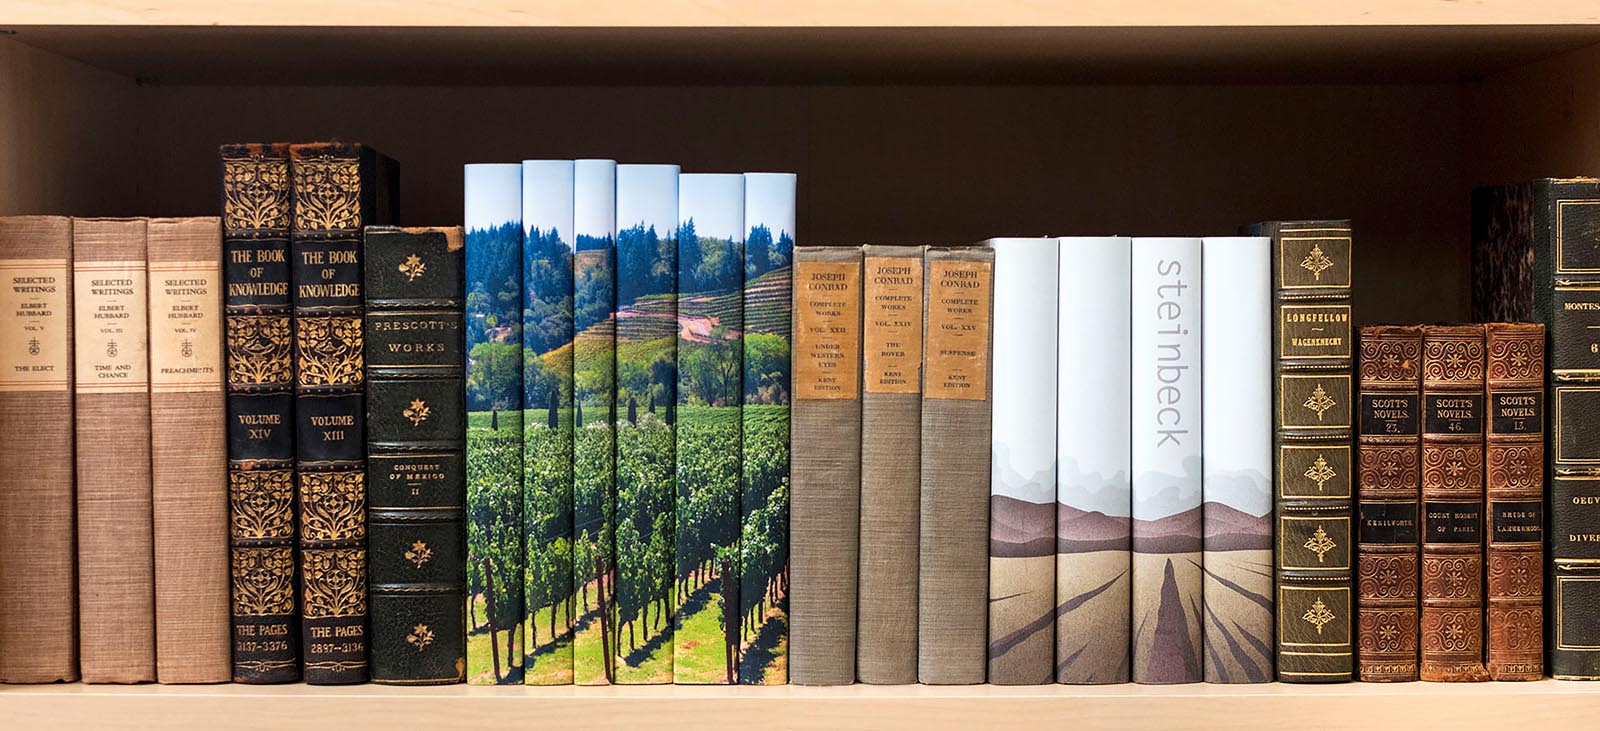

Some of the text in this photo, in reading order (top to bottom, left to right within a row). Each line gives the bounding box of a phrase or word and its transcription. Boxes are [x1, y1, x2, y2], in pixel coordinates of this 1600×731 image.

[231, 249, 285, 263] THE BOOK
[302, 251, 357, 264] THE BOOK
[250, 268, 264, 278] OF
[321, 269, 336, 279] OF
[812, 273, 845, 281] JOSEPH
[944, 270, 977, 279] JOSEPH
[91, 279, 133, 287] SELECTED
[165, 279, 207, 287] SELECTED
[874, 277, 913, 285] CONRAD
[941, 280, 980, 289] CONRAD
[229, 282, 288, 296] KNOWLEDGE
[299, 283, 360, 298] KNOWLEDGE
[808, 283, 848, 291] CONRAD
[91, 288, 134, 296] WRITINGS
[165, 288, 207, 296] WRITINGS
[1564, 302, 1600, 311] MONTES
[1287, 314, 1348, 322] LONGFELLOW
[374, 321, 458, 330] PRESCOTT'S
[1292, 338, 1342, 346] WAGENKNECHT
[388, 343, 445, 352] WORKS
[1591, 343, 1599, 353] 6
[1157, 260, 1189, 448] steinbeck
[1372, 400, 1408, 408] SCOTT'S
[1437, 400, 1472, 408] SCOTT'S
[1500, 397, 1536, 406] SCOTT'S
[238, 414, 281, 425] VOLUME
[311, 416, 354, 426] VOLUME
[249, 429, 271, 439] XIV
[323, 431, 344, 440] XIII
[236, 624, 288, 636] THE PAGES
[310, 625, 364, 638] THE PAGES
[237, 641, 288, 652] 3137-3376
